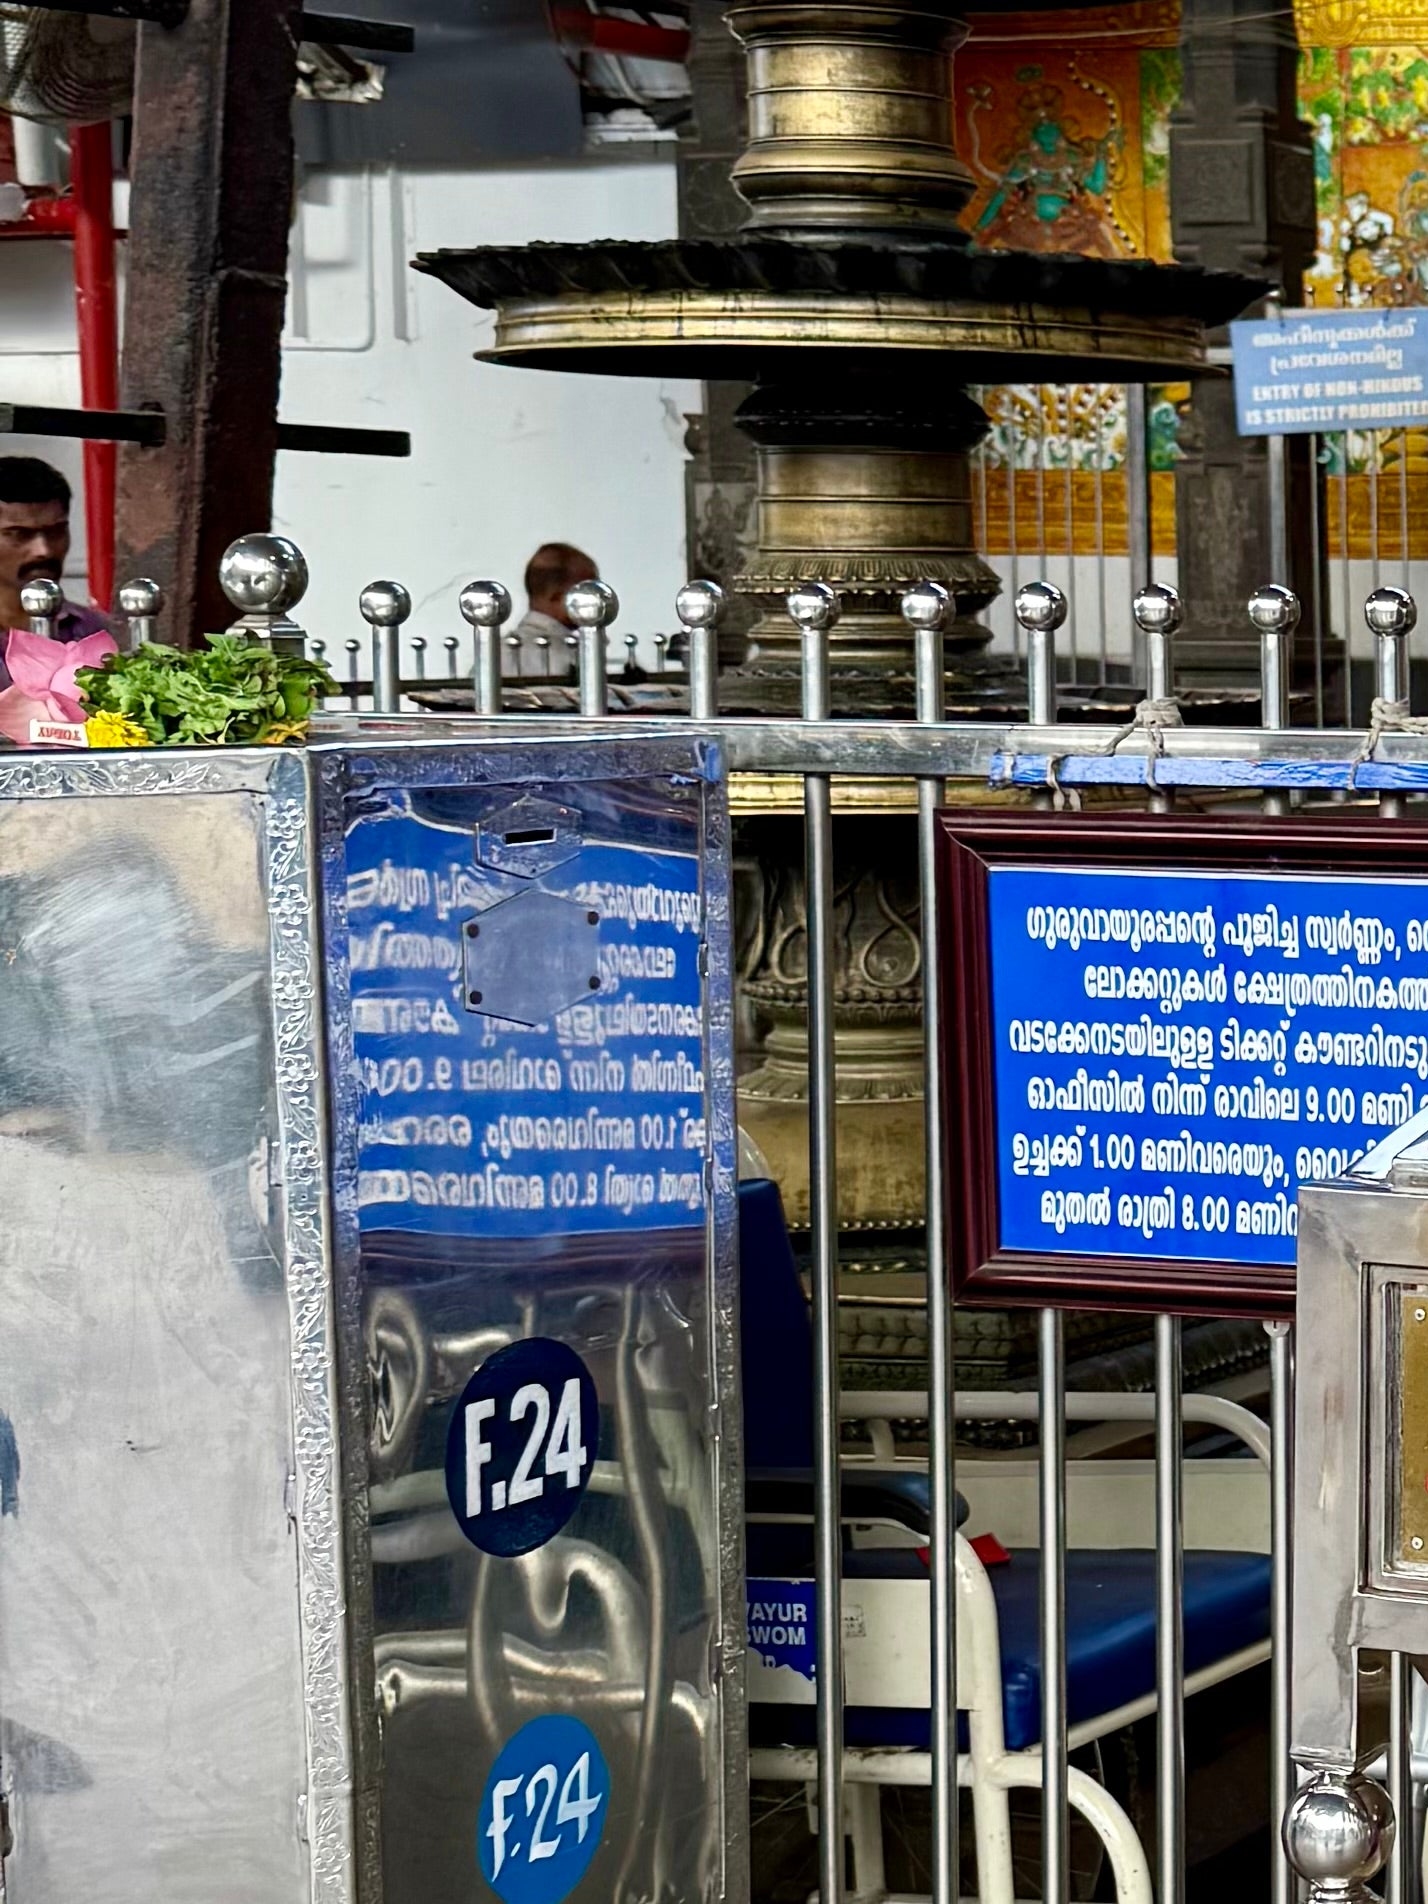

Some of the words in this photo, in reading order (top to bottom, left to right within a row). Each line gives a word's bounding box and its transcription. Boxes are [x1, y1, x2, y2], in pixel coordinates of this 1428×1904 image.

[1253, 384, 1299, 402] ENTRY
[1303, 383, 1321, 398] OF
[1245, 409, 1262, 425] IS
[1265, 405, 1334, 424] STRICTLY
[1215, 1077, 1299, 1123] രാവിലെ
[1307, 1085, 1354, 1125] 9.00
[1362, 1081, 1413, 1126] മണി
[1090, 1133, 1134, 1170] 1.00
[1041, 1189, 1110, 1233] മുതൽ
[1118, 1188, 1175, 1238] രാത്രി
[1182, 1195, 1228, 1232] 8.00
[465, 1378, 587, 1518] F.24
[746, 1603, 807, 1622] AYUR
[746, 1626, 806, 1645] WOM
[486, 1752, 602, 1881] F.24
